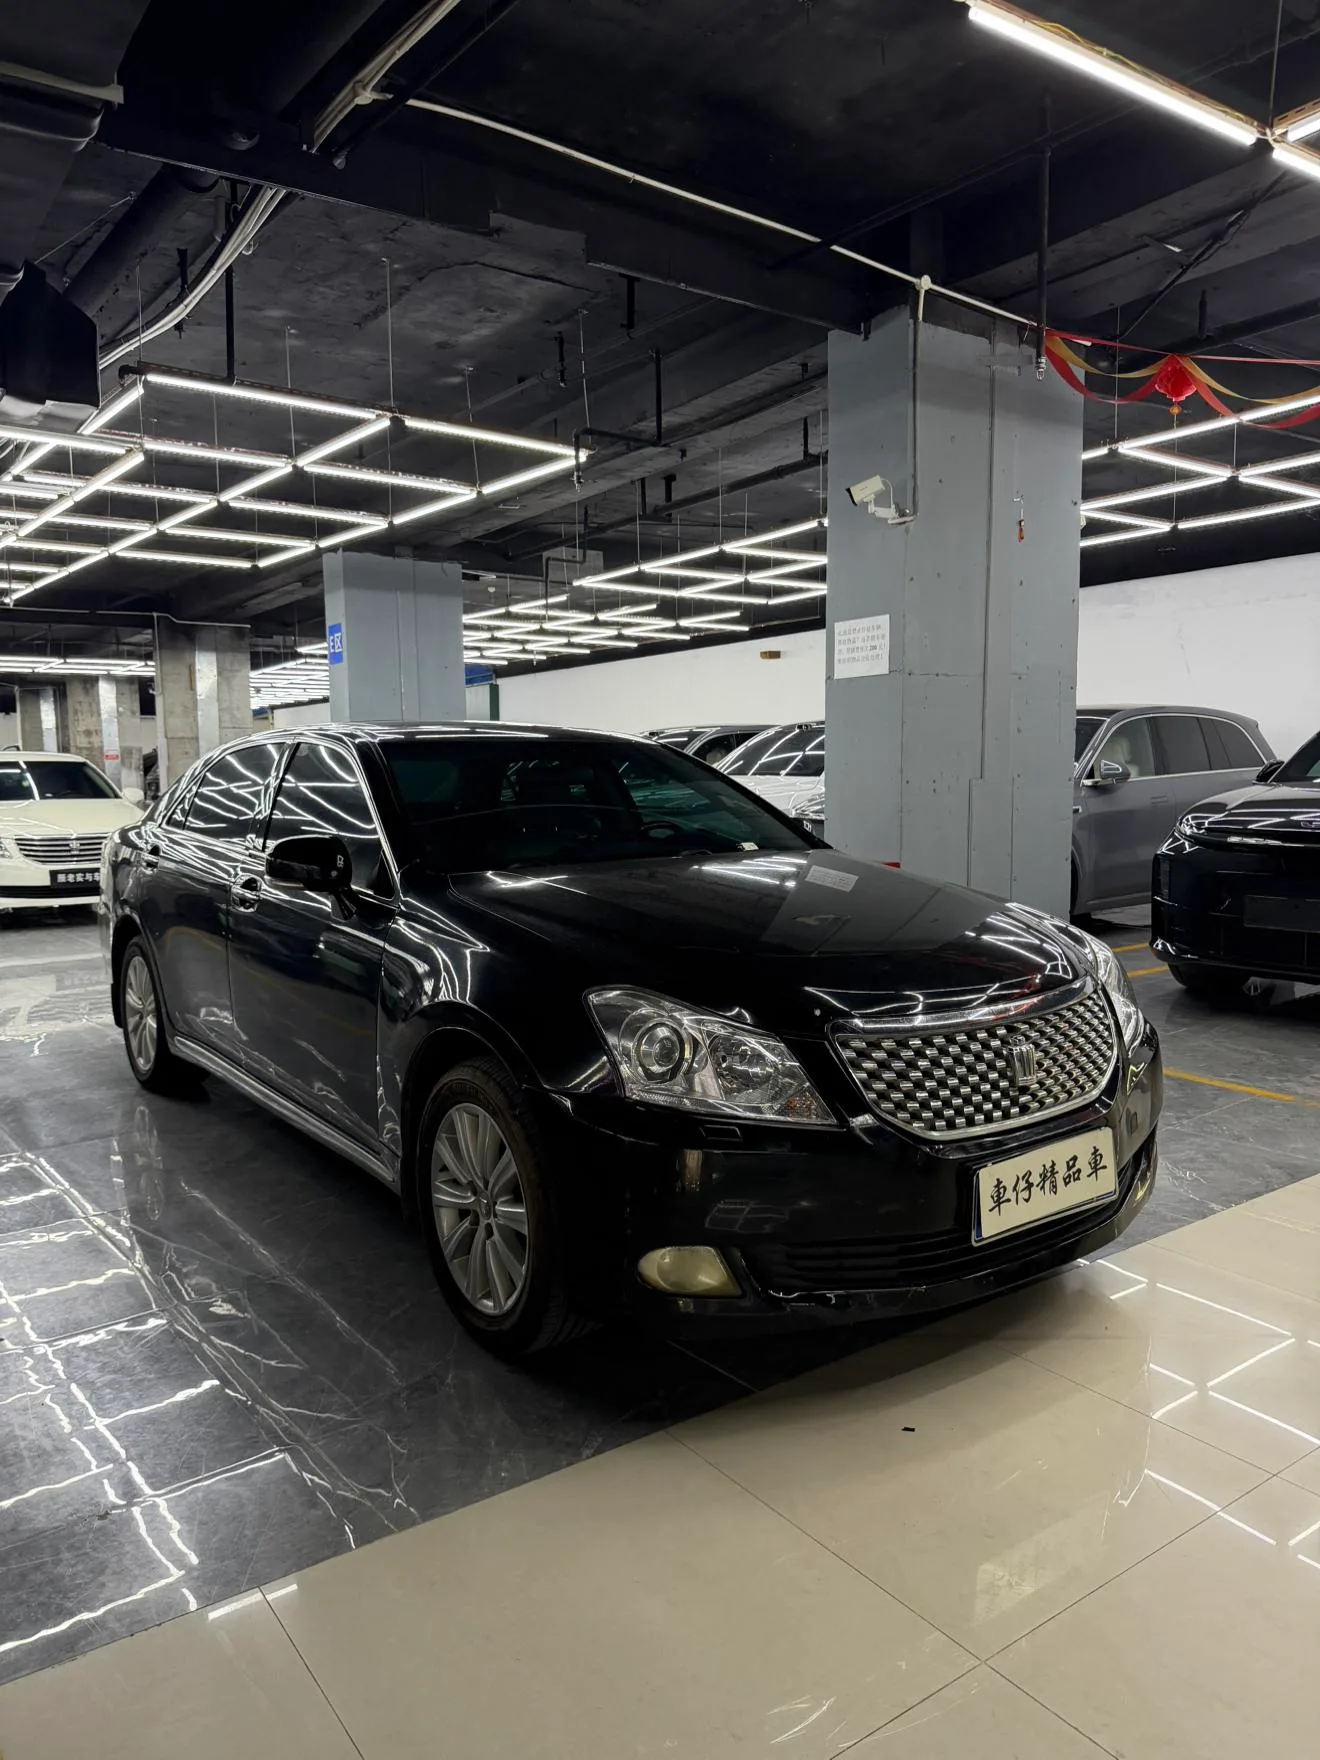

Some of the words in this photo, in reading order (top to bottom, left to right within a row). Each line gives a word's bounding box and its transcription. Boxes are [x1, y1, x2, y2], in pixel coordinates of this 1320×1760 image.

[329, 632, 343, 653] E区
[988, 1146, 1108, 1216] 車仔精品車
